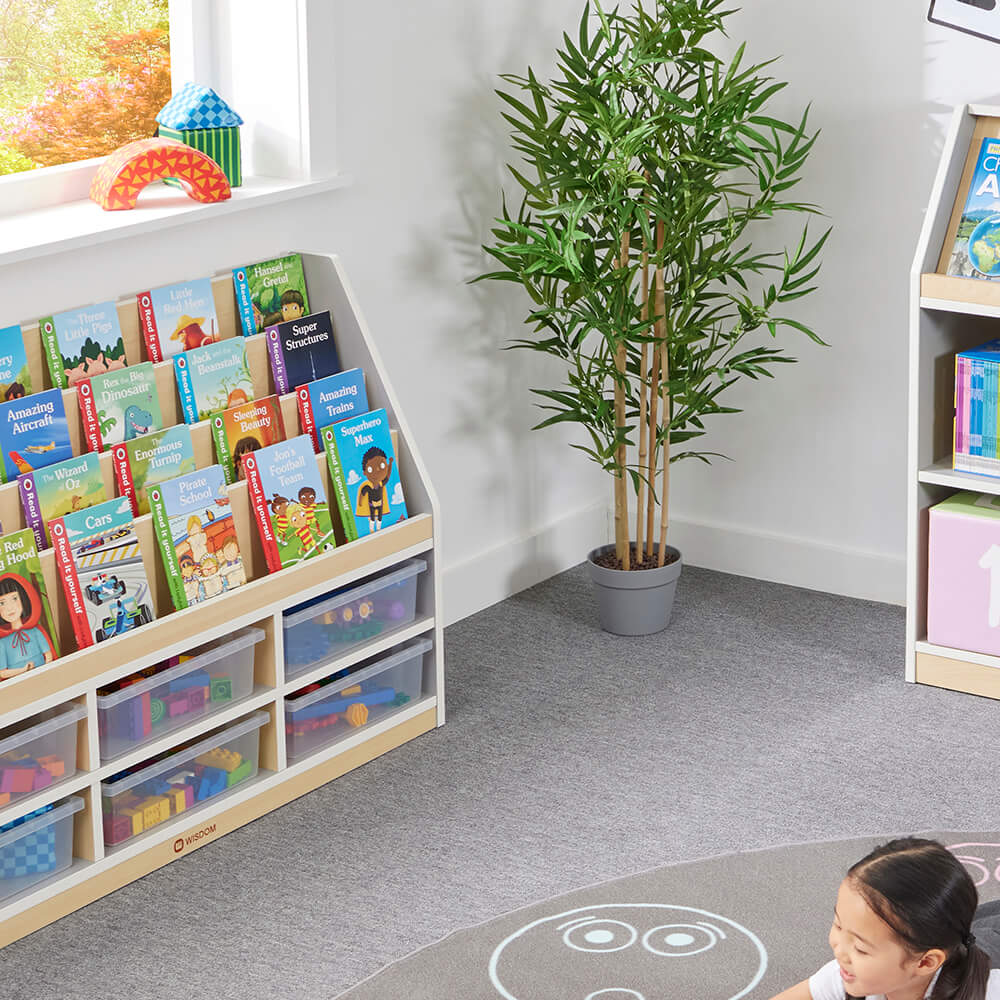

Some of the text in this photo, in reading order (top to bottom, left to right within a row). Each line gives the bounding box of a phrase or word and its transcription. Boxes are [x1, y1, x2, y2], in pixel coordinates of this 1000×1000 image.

[254, 262, 283, 278] Hansel
[263, 273, 289, 288] Gretel
[240, 284, 248, 306] Read
[144, 309, 154, 333] Read
[292, 322, 318, 336] Super
[48, 335, 58, 360] Read
[286, 332, 329, 351] Structures
[272, 342, 281, 365] Read
[103, 371, 145, 390] Rex Big
[180, 369, 190, 394] Read
[101, 384, 151, 404] Dinosaur
[319, 384, 358, 404] Amazing
[7, 402, 55, 423] Amazing
[84, 398, 95, 421] Read
[233, 405, 267, 423] Sleeping
[303, 403, 312, 428] Read
[326, 401, 354, 417] Trains
[12, 414, 53, 435] Aircraft
[240, 415, 271, 433] Beauty
[340, 417, 382, 437] Superhero
[134, 440, 183, 461] Enormous
[218, 430, 228, 457] Read
[354, 434, 374, 448] Max
[149, 452, 183, 470] Turnip
[274, 447, 296, 462] Jon's
[54, 461, 89, 480] Wizard
[120, 461, 130, 489] Read
[269, 456, 305, 476] Football
[65, 477, 81, 490] Oz
[178, 477, 207, 493] Pirate
[278, 471, 304, 487] Team
[328, 442, 338, 466] Read
[335, 476, 350, 511] yourself
[27, 492, 38, 518] Read
[179, 487, 213, 507] School
[249, 470, 260, 496] Read
[256, 505, 273, 541] yourself
[85, 513, 113, 530] Cars
[4, 537, 24, 551] Red
[154, 503, 166, 530] Read
[161, 540, 179, 577] yourself
[7, 547, 37, 567] Hood
[57, 537, 70, 563] Read
[65, 573, 83, 615] yourself
[185, 823, 216, 845] WISDOM
